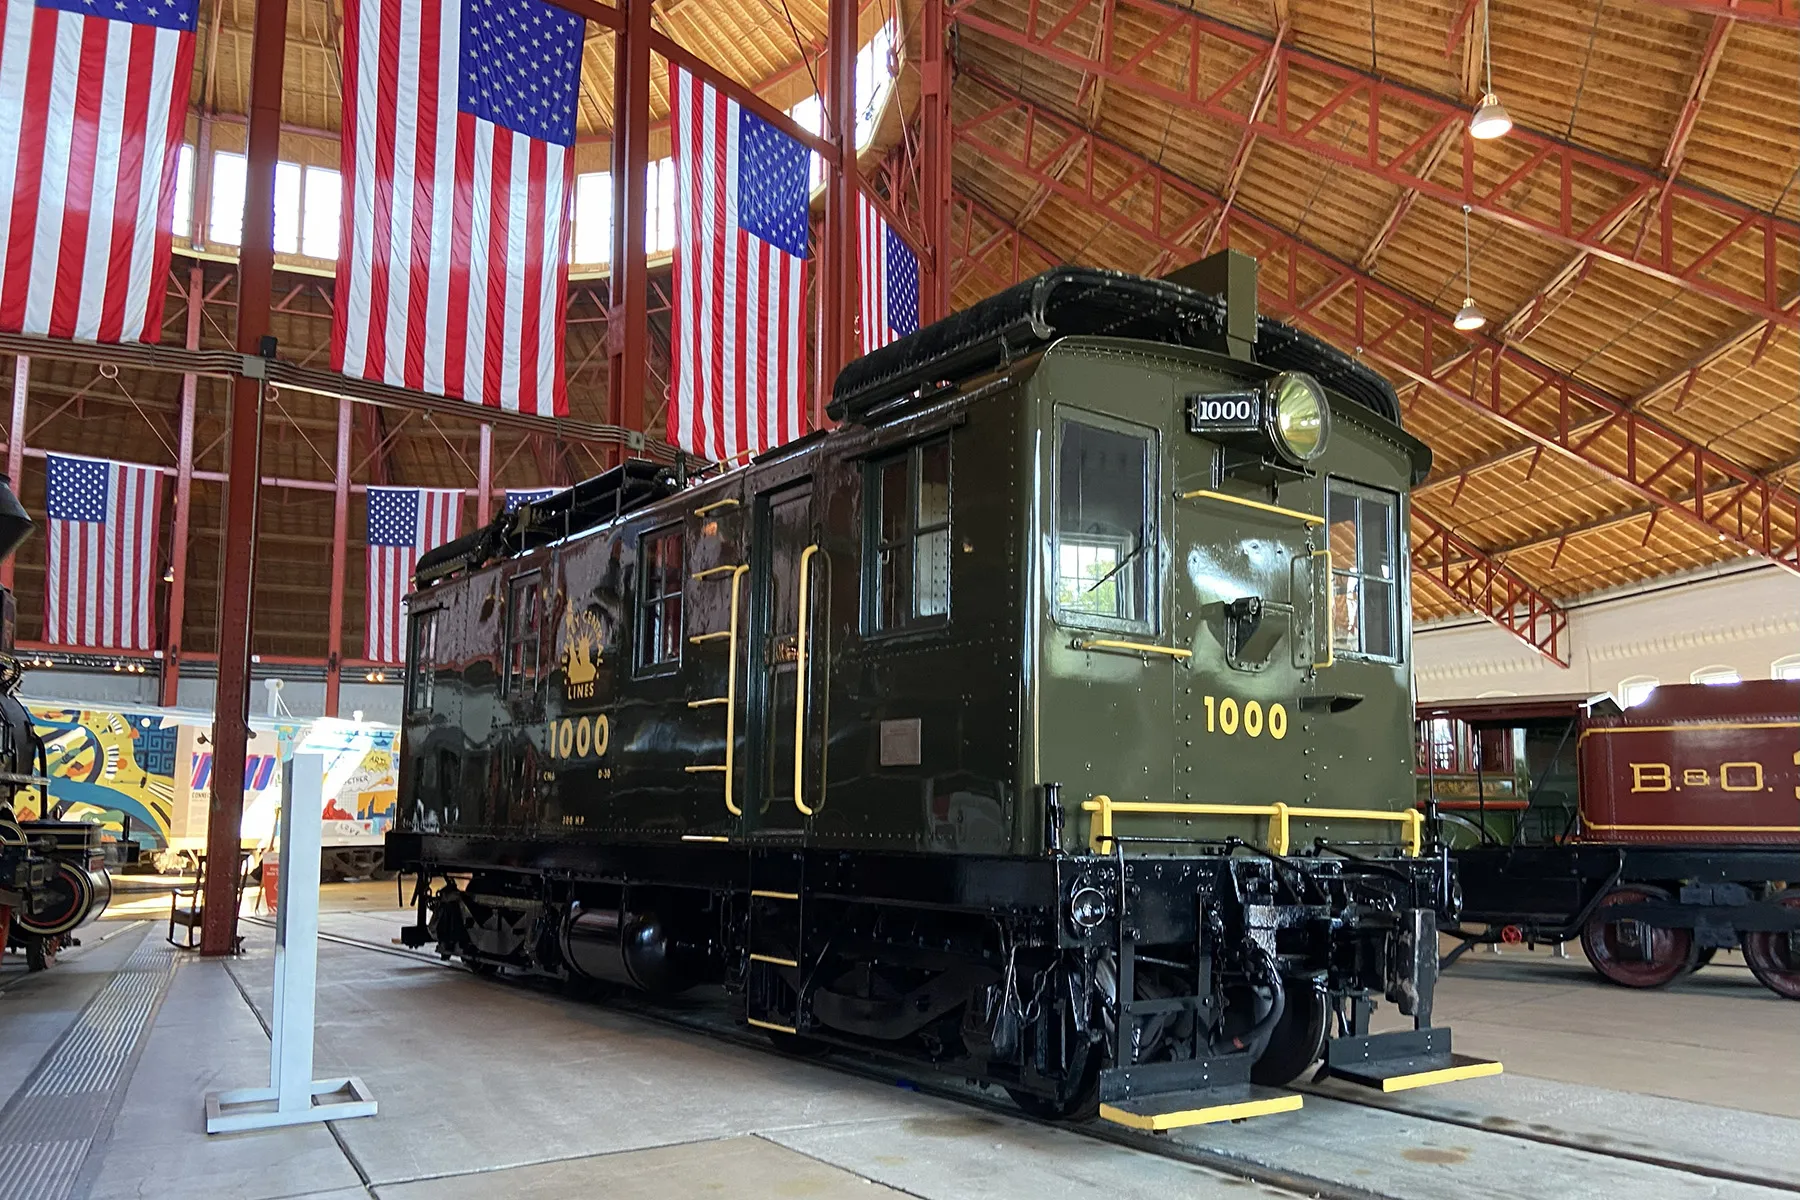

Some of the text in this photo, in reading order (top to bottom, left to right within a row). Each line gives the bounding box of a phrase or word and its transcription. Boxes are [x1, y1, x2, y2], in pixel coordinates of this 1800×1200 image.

[1200, 401, 1250, 420] 1000
[567, 682, 594, 700] LINES
[1204, 695, 1287, 740] 1000
[549, 713, 609, 759] 1000
